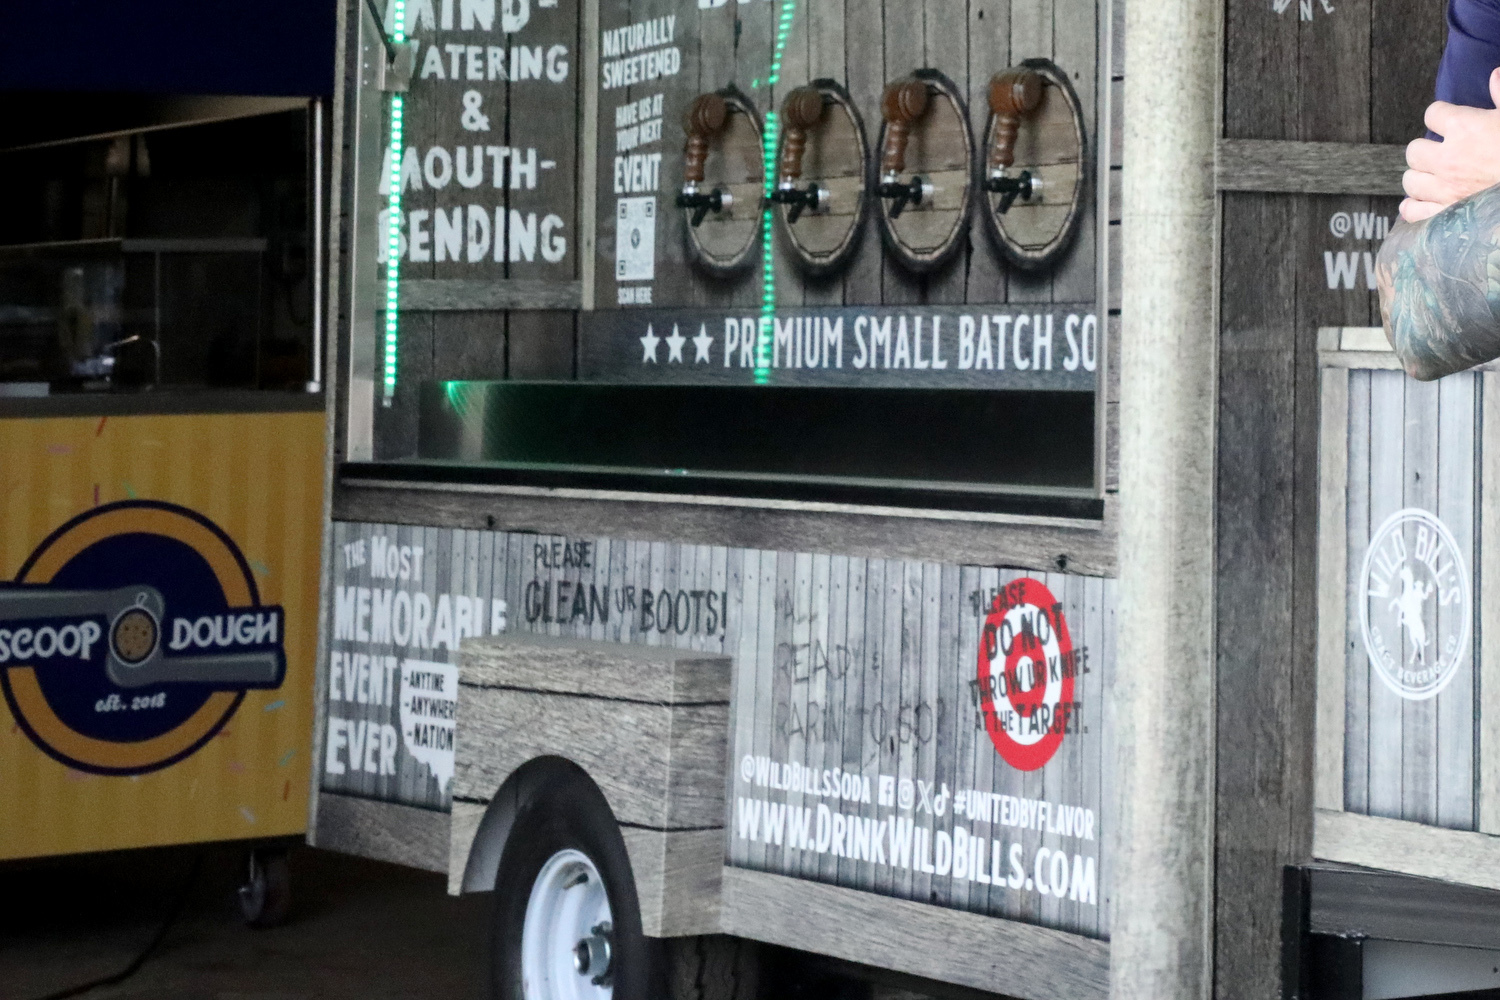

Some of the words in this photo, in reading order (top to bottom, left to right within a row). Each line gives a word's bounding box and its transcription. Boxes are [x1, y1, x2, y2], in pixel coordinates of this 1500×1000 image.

[603, 15, 676, 57] NATURALLY
[603, 47, 681, 89] SWEETENED
[461, 89, 491, 131] &
[614, 153, 662, 194] EVENT
[724, 316, 843, 369] PREMIUM
[852, 315, 948, 371] SMALL
[959, 314, 1053, 370] BATCH
[345, 539, 366, 569] THE
[371, 536, 424, 581] MOST
[533, 541, 593, 569] PLEASE
[1368, 528, 1407, 598] WILD
[524, 580, 609, 625] CLEAN
[640, 588, 728, 643] BOOTS!
[969, 582, 1027, 617] PLEASE
[0, 620, 101, 663] SCOOP
[169, 612, 279, 650] DOUGH
[985, 618, 1015, 661] DO
[1021, 602, 1063, 650] NOT
[331, 652, 399, 706] EVENT
[969, 667, 1024, 707] THROW
[1049, 646, 1091, 684] KNIFE
[94, 693, 127, 712] est.
[993, 710, 1014, 733] THE
[326, 716, 398, 776] EVER
[953, 789, 1095, 841] #UNITEDBYFLAVOR
